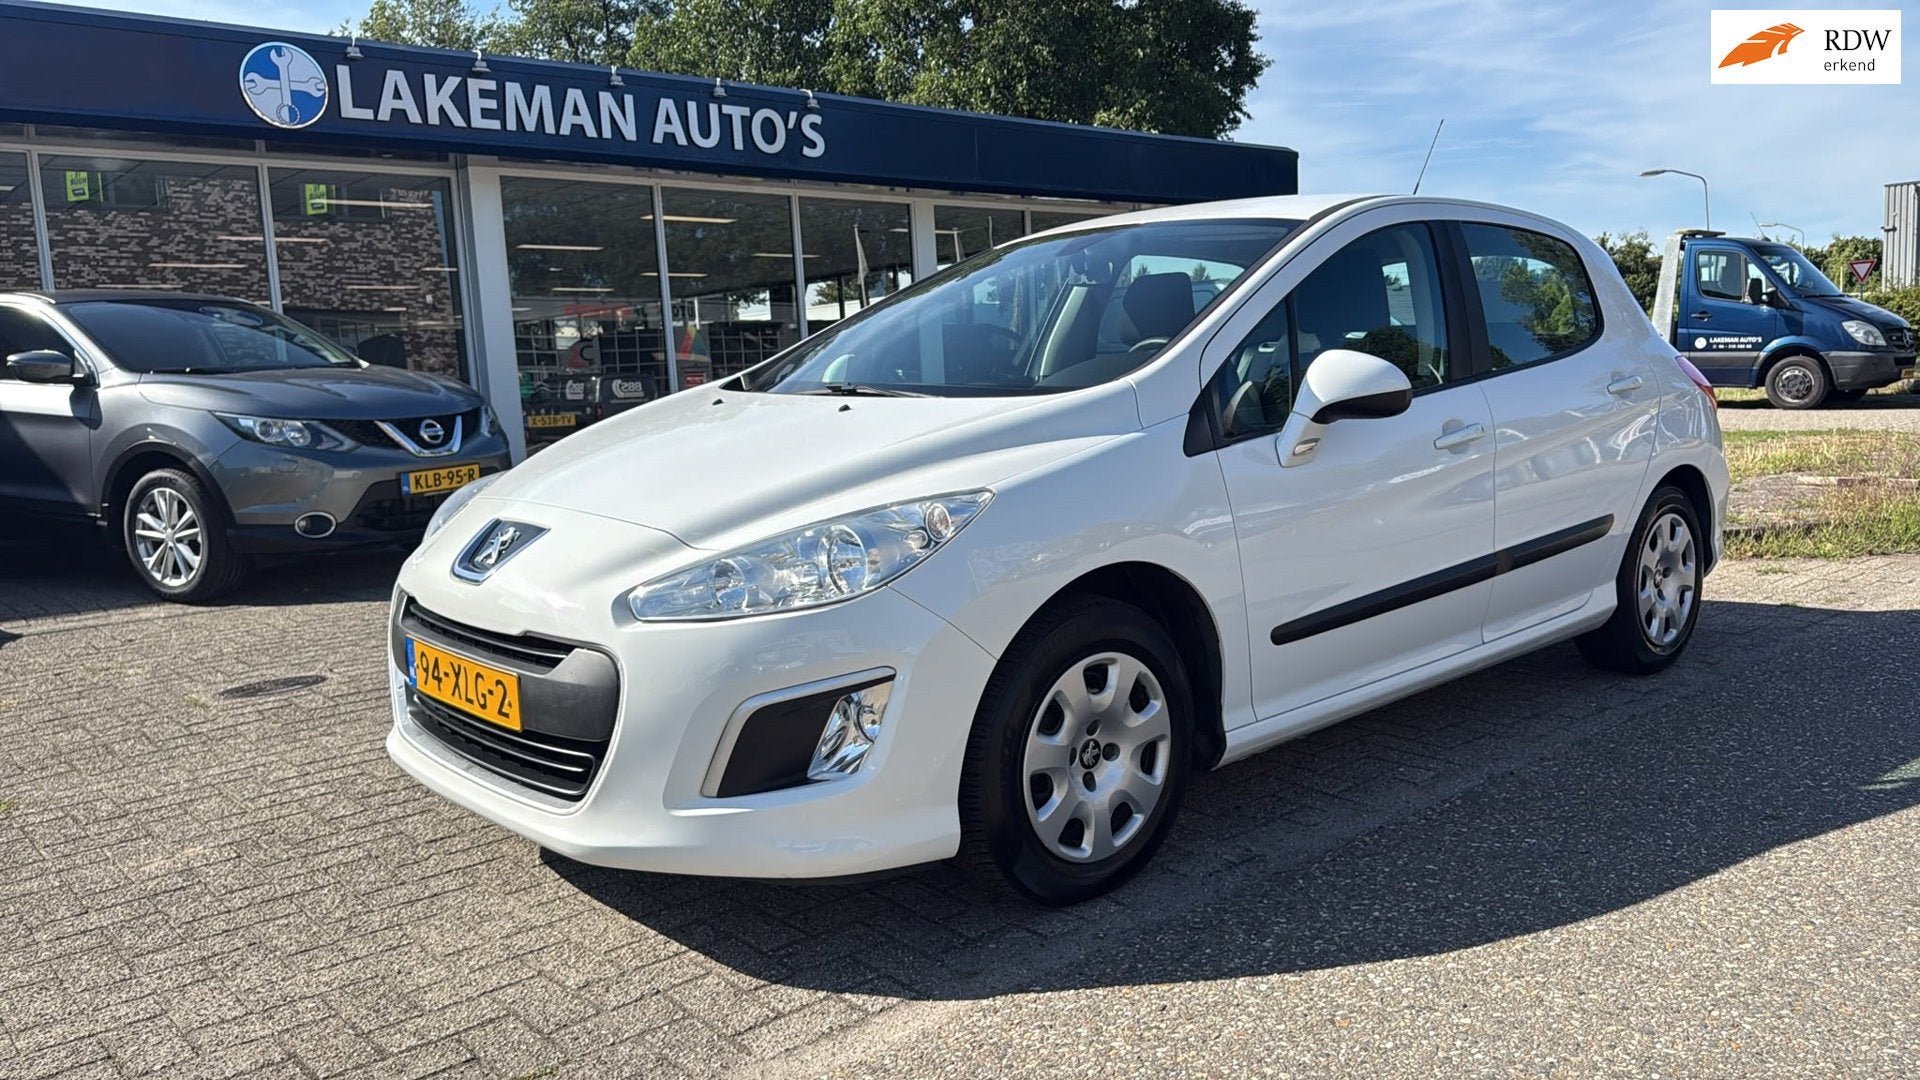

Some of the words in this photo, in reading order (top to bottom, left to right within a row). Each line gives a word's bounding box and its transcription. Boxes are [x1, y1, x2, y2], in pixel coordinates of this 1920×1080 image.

[335, 64, 637, 142] LAKEMAN
[652, 98, 826, 158] AUTO'S
[414, 468, 475, 490] KLB-95-R
[420, 650, 510, 719] 94-XLG-2
